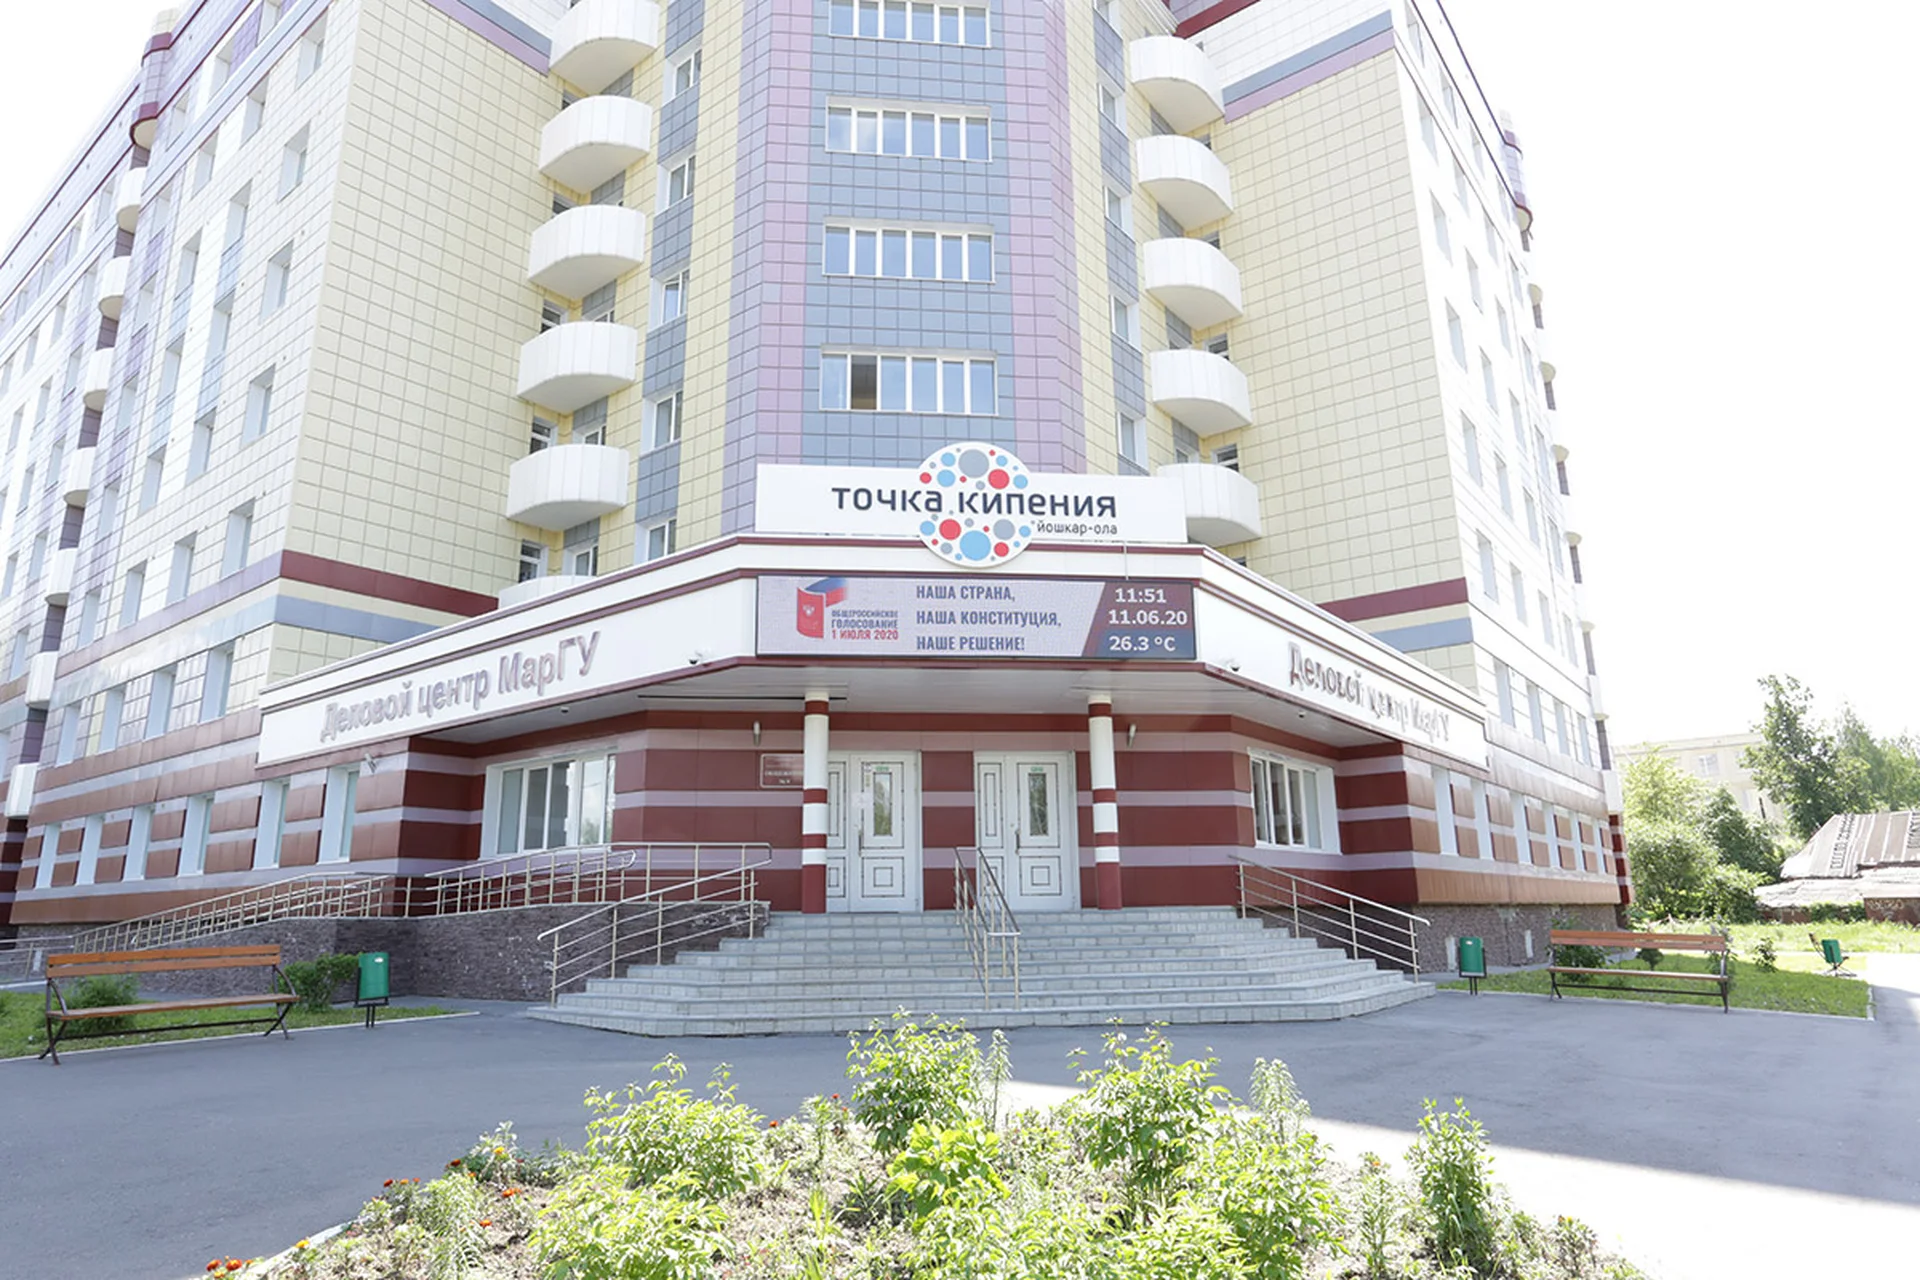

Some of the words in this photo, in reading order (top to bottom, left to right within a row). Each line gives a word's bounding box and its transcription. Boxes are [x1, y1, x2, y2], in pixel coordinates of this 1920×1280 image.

[832, 487, 943, 513] точка
[958, 491, 1117, 518] кипения
[1036, 518, 1118, 536] йошкар-ола
[916, 585, 956, 599] НАША
[960, 586, 1016, 602] СТРАНА,
[1115, 587, 1167, 603] 11:51
[831, 619, 899, 629] ГОЛОСОВАНИЕ
[916, 610, 956, 625] НАША
[960, 611, 1062, 628] КОНСТИТУЦИЯ,
[1108, 609, 1188, 625] 11.06.20
[832, 629, 836, 639] 1
[840, 629, 871, 640] ИЮЛЯ
[874, 629, 899, 640] 2020
[916, 636, 956, 651] НАШЕ
[959, 636, 1025, 651] РЕШЕНИЕ!
[1109, 635, 1149, 651] 26.3
[1288, 641, 1365, 708] Деловой
[320, 682, 413, 742] Деловой
[417, 668, 490, 718] центр
[498, 630, 602, 696] МарГУ
